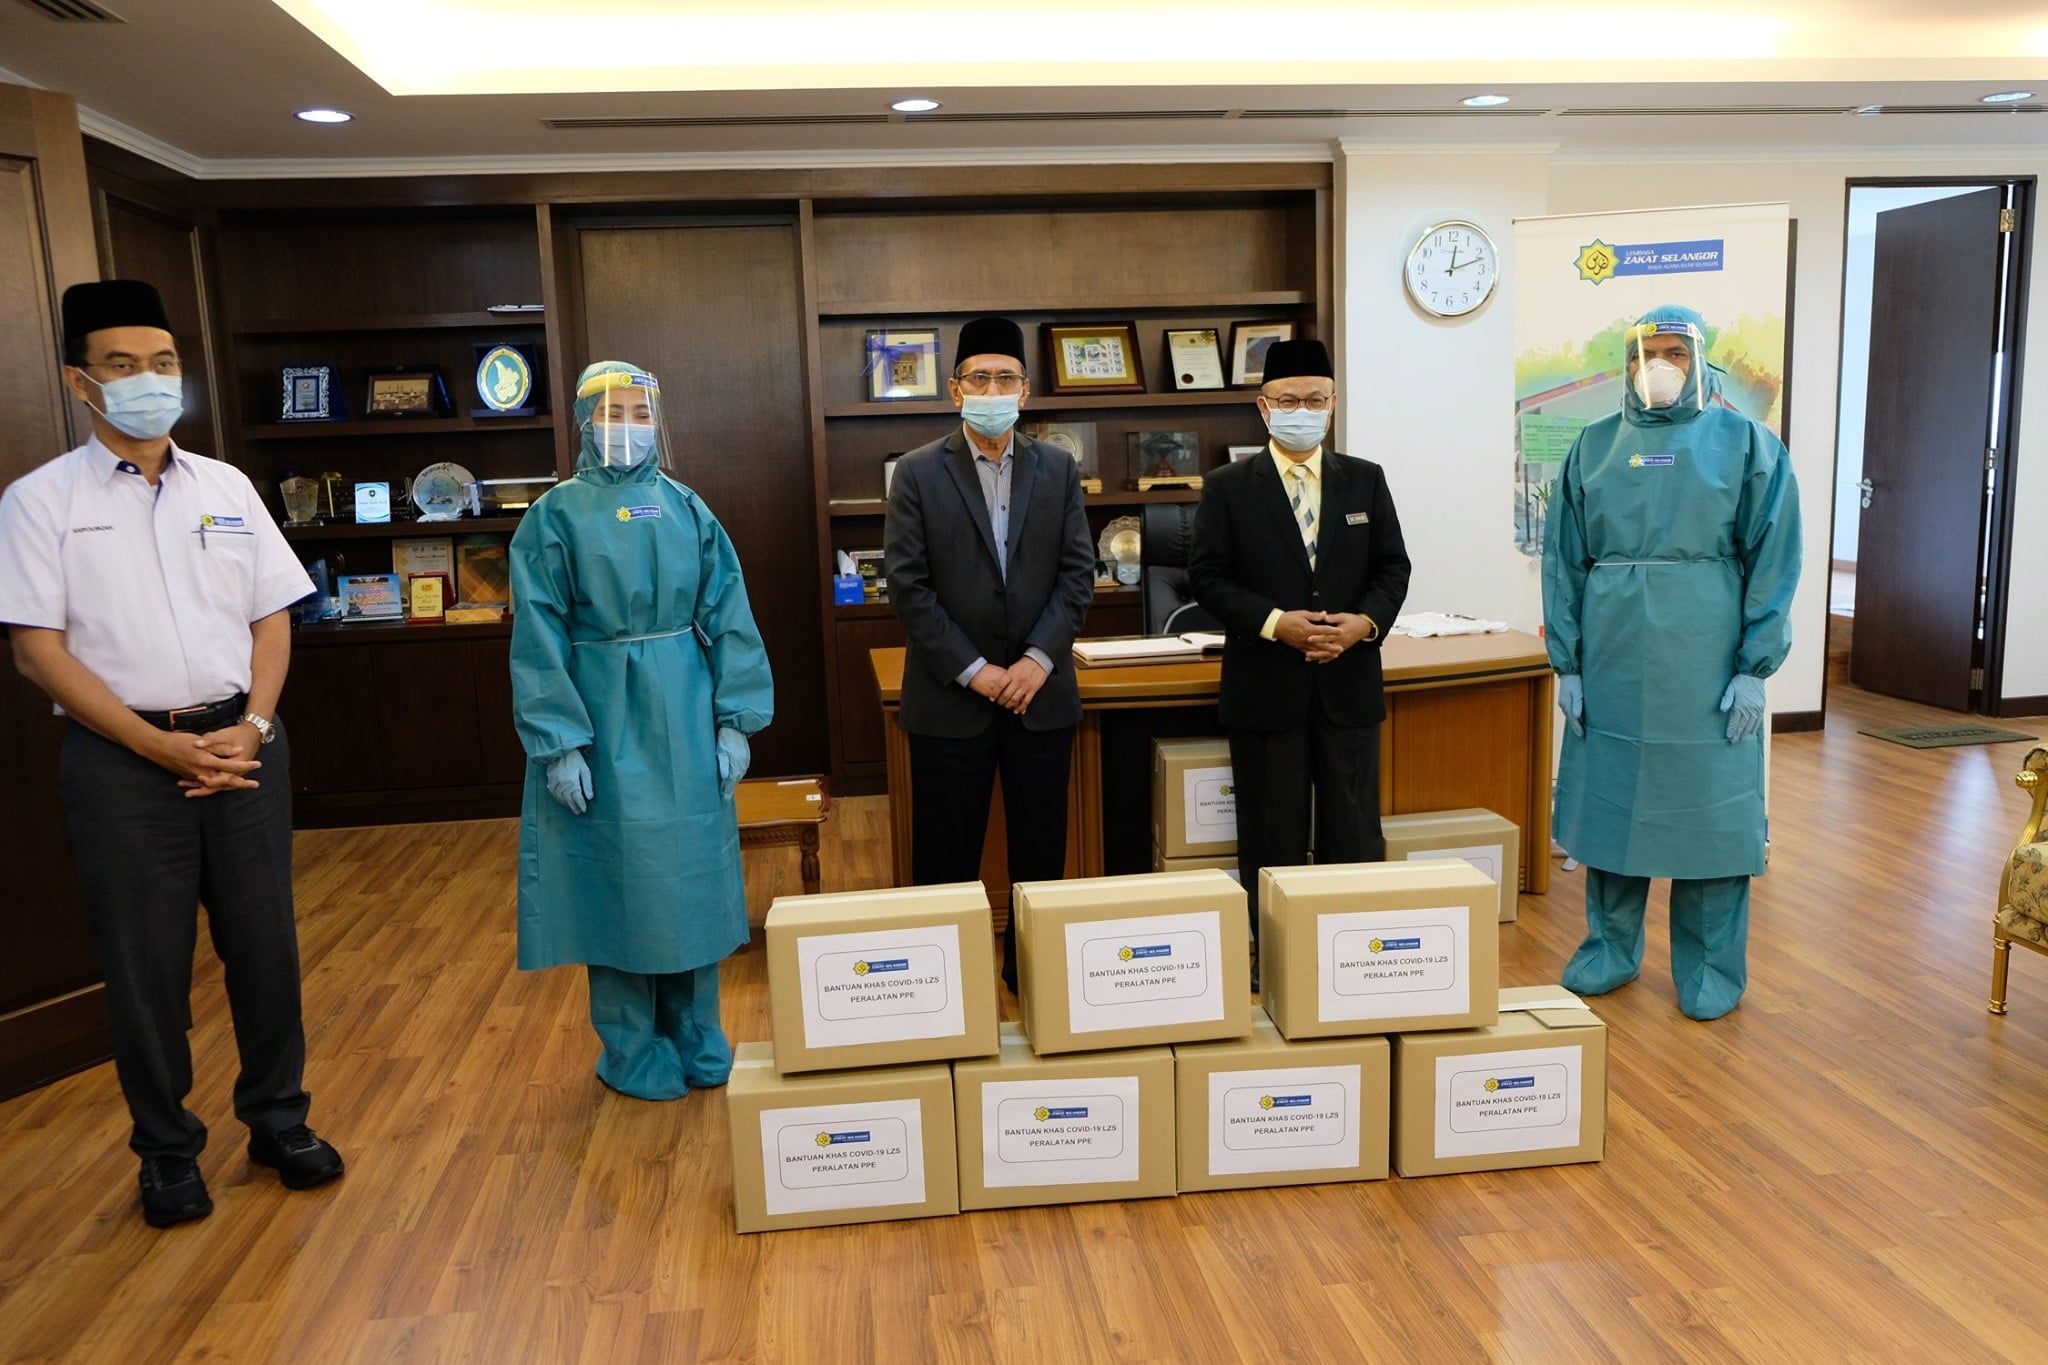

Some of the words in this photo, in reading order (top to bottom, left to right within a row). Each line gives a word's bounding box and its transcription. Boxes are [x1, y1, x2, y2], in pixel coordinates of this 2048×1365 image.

[1448, 231, 1459, 242] 12
[1476, 248, 1483, 259] 2
[1624, 255, 1659, 264] ZAKAT
[1660, 252, 1718, 262] SELANGOR
[1418, 263, 1424, 275] 9
[1478, 264, 1485, 275] 3
[1420, 280, 1428, 291] 8
[1474, 280, 1480, 291] 4
[1432, 292, 1438, 303] 7
[1446, 296, 1453, 307] 6
[1462, 292, 1468, 304] 5
[1089, 968, 1126, 978] BANTUAN
[1128, 966, 1149, 974] KHAS
[1151, 964, 1184, 972] COVID-19
[1364, 971, 1408, 979] PERALATAN
[824, 983, 862, 992] BANTUAN
[864, 980, 886, 988] KHAS
[888, 978, 923, 987] COVID-19
[1115, 979, 1160, 988] PERALATAN
[850, 993, 897, 1002] PERALATAN
[1456, 1098, 1491, 1107] BANTUAN
[1479, 1108, 1522, 1116] PERALATAN
[1230, 1115, 1266, 1124] BANTUAN
[1268, 1114, 1288, 1122] KHAS
[1030, 1139, 1075, 1147] PERALATAN
[786, 1154, 824, 1162] BANTUAN
[849, 1149, 884, 1157] COVID-19
[812, 1164, 859, 1172] PERALATAN
